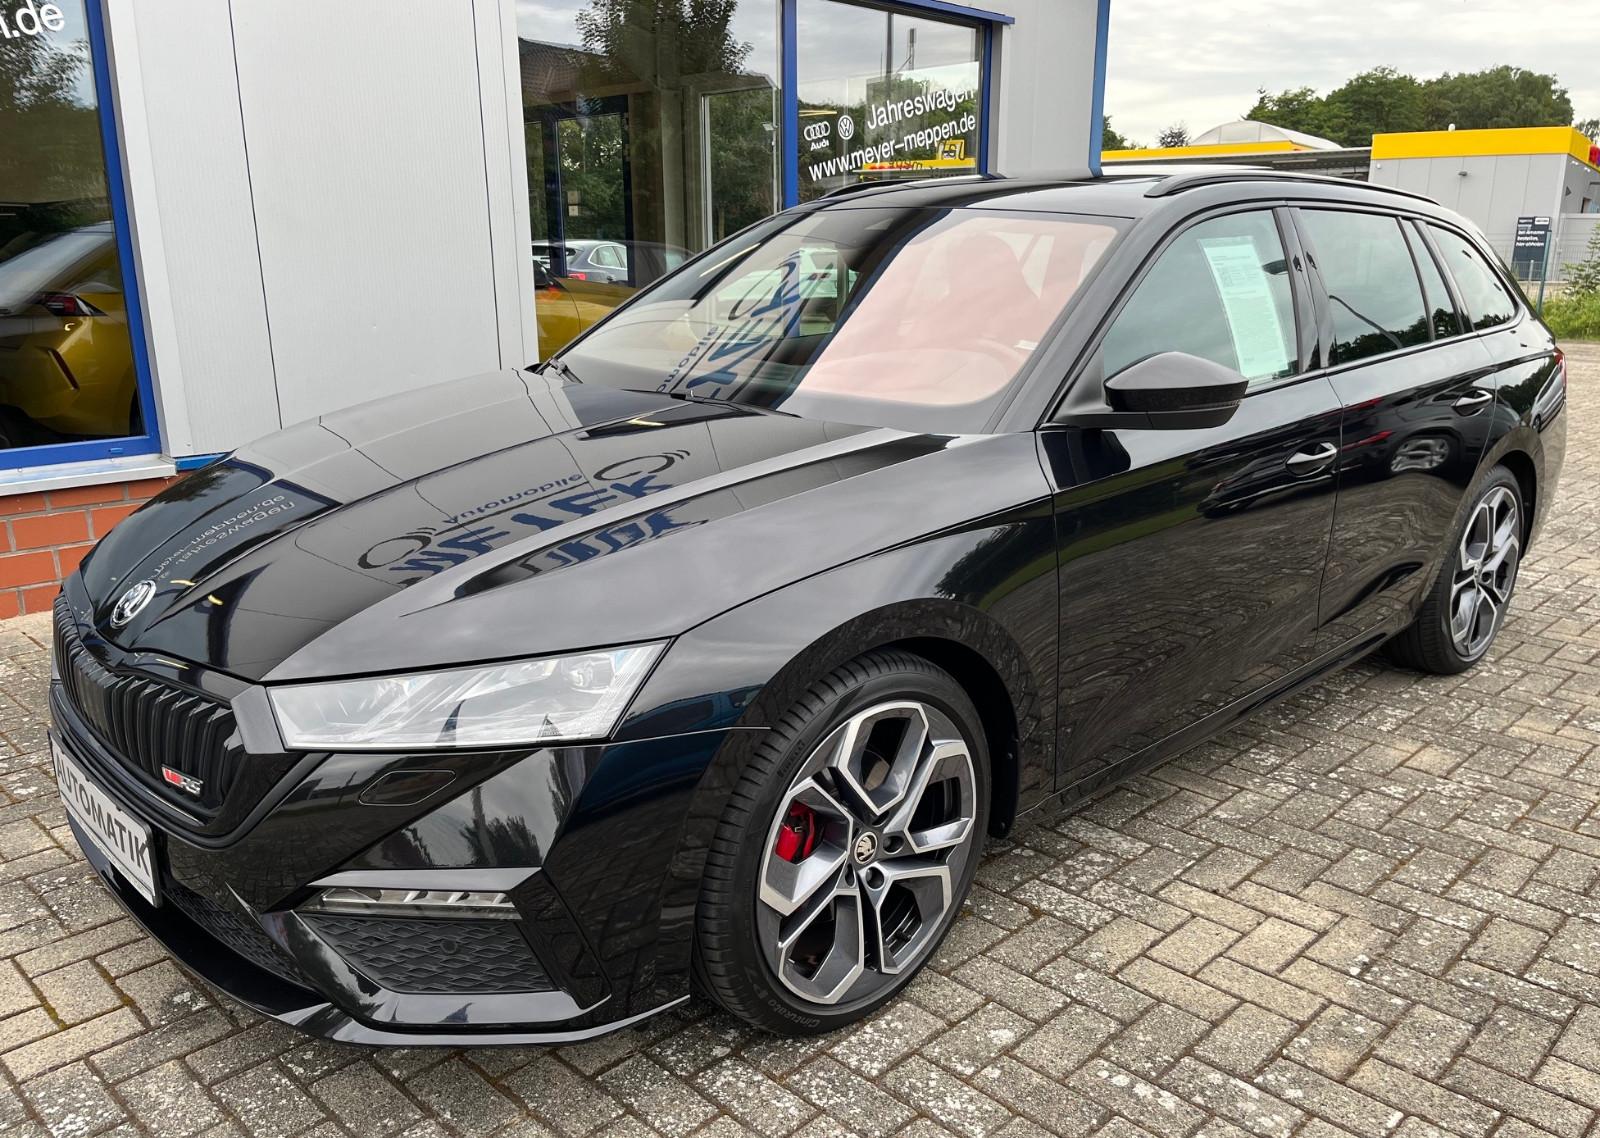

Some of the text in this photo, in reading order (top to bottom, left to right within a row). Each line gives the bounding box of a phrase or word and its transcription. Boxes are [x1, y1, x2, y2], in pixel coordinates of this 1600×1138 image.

[867, 87, 974, 130] Jahreswagen
[808, 112, 976, 182] www.meyer-meppen.de
[810, 140, 830, 151] Audi
[56, 752, 150, 876] AUTOMATIK
